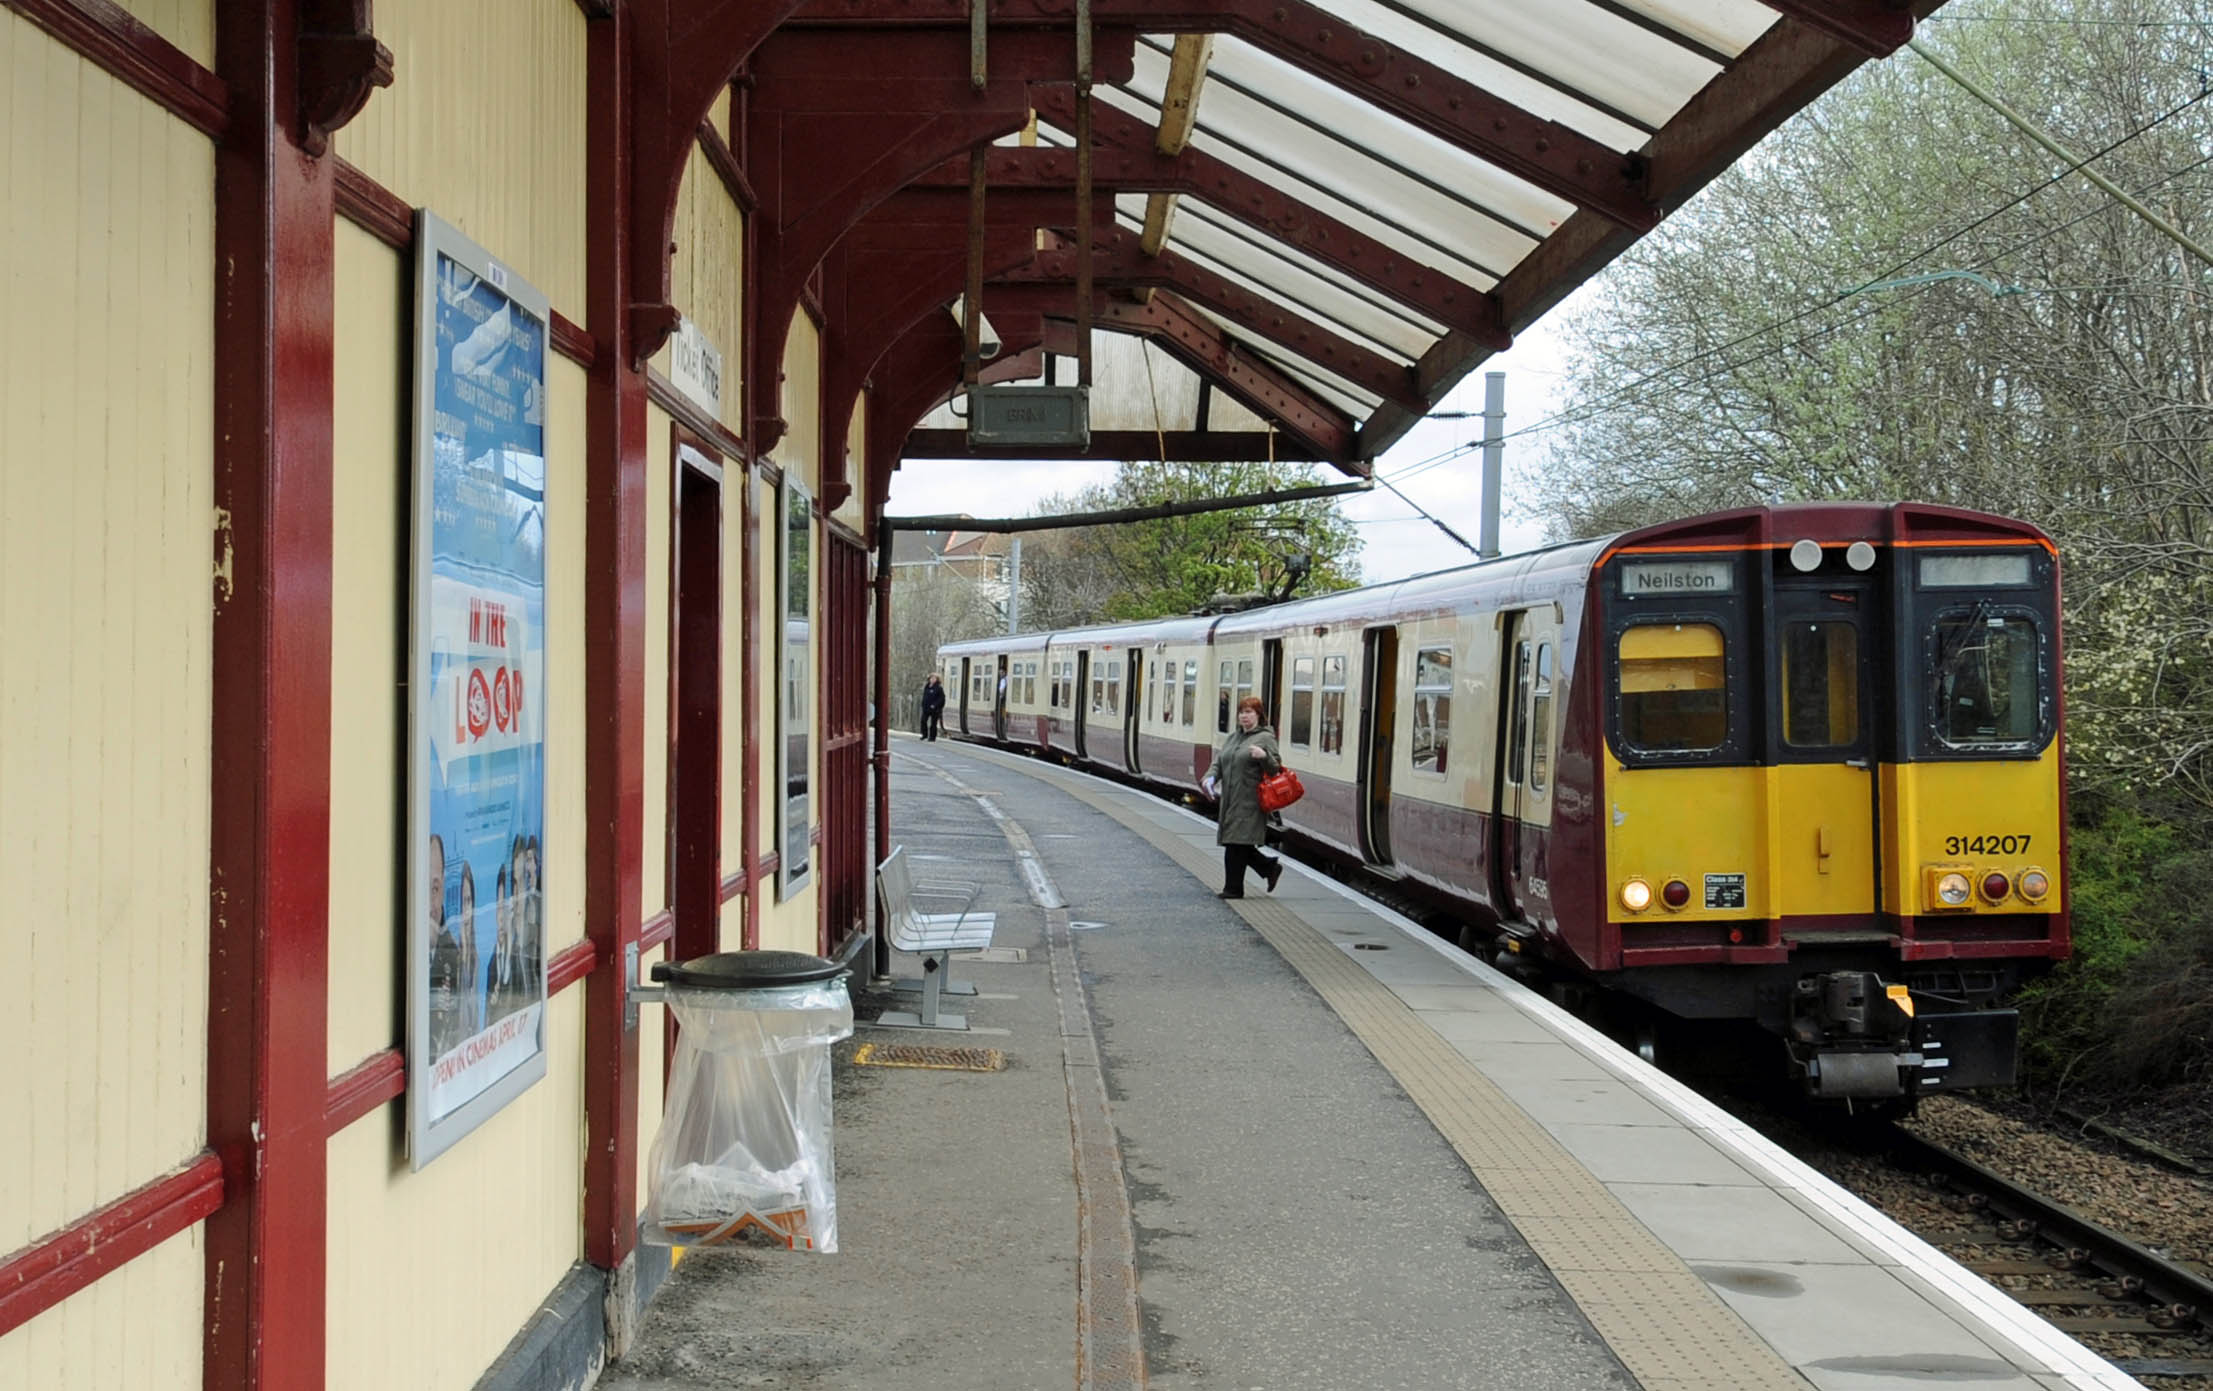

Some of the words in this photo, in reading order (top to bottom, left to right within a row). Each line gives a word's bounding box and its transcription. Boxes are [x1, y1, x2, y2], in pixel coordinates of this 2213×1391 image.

[1638, 572, 1716, 589] Neilston
[469, 597, 481, 644] IN
[484, 600, 506, 648] THE
[455, 666, 523, 745] LOOP
[1945, 835, 2032, 856] 314207
